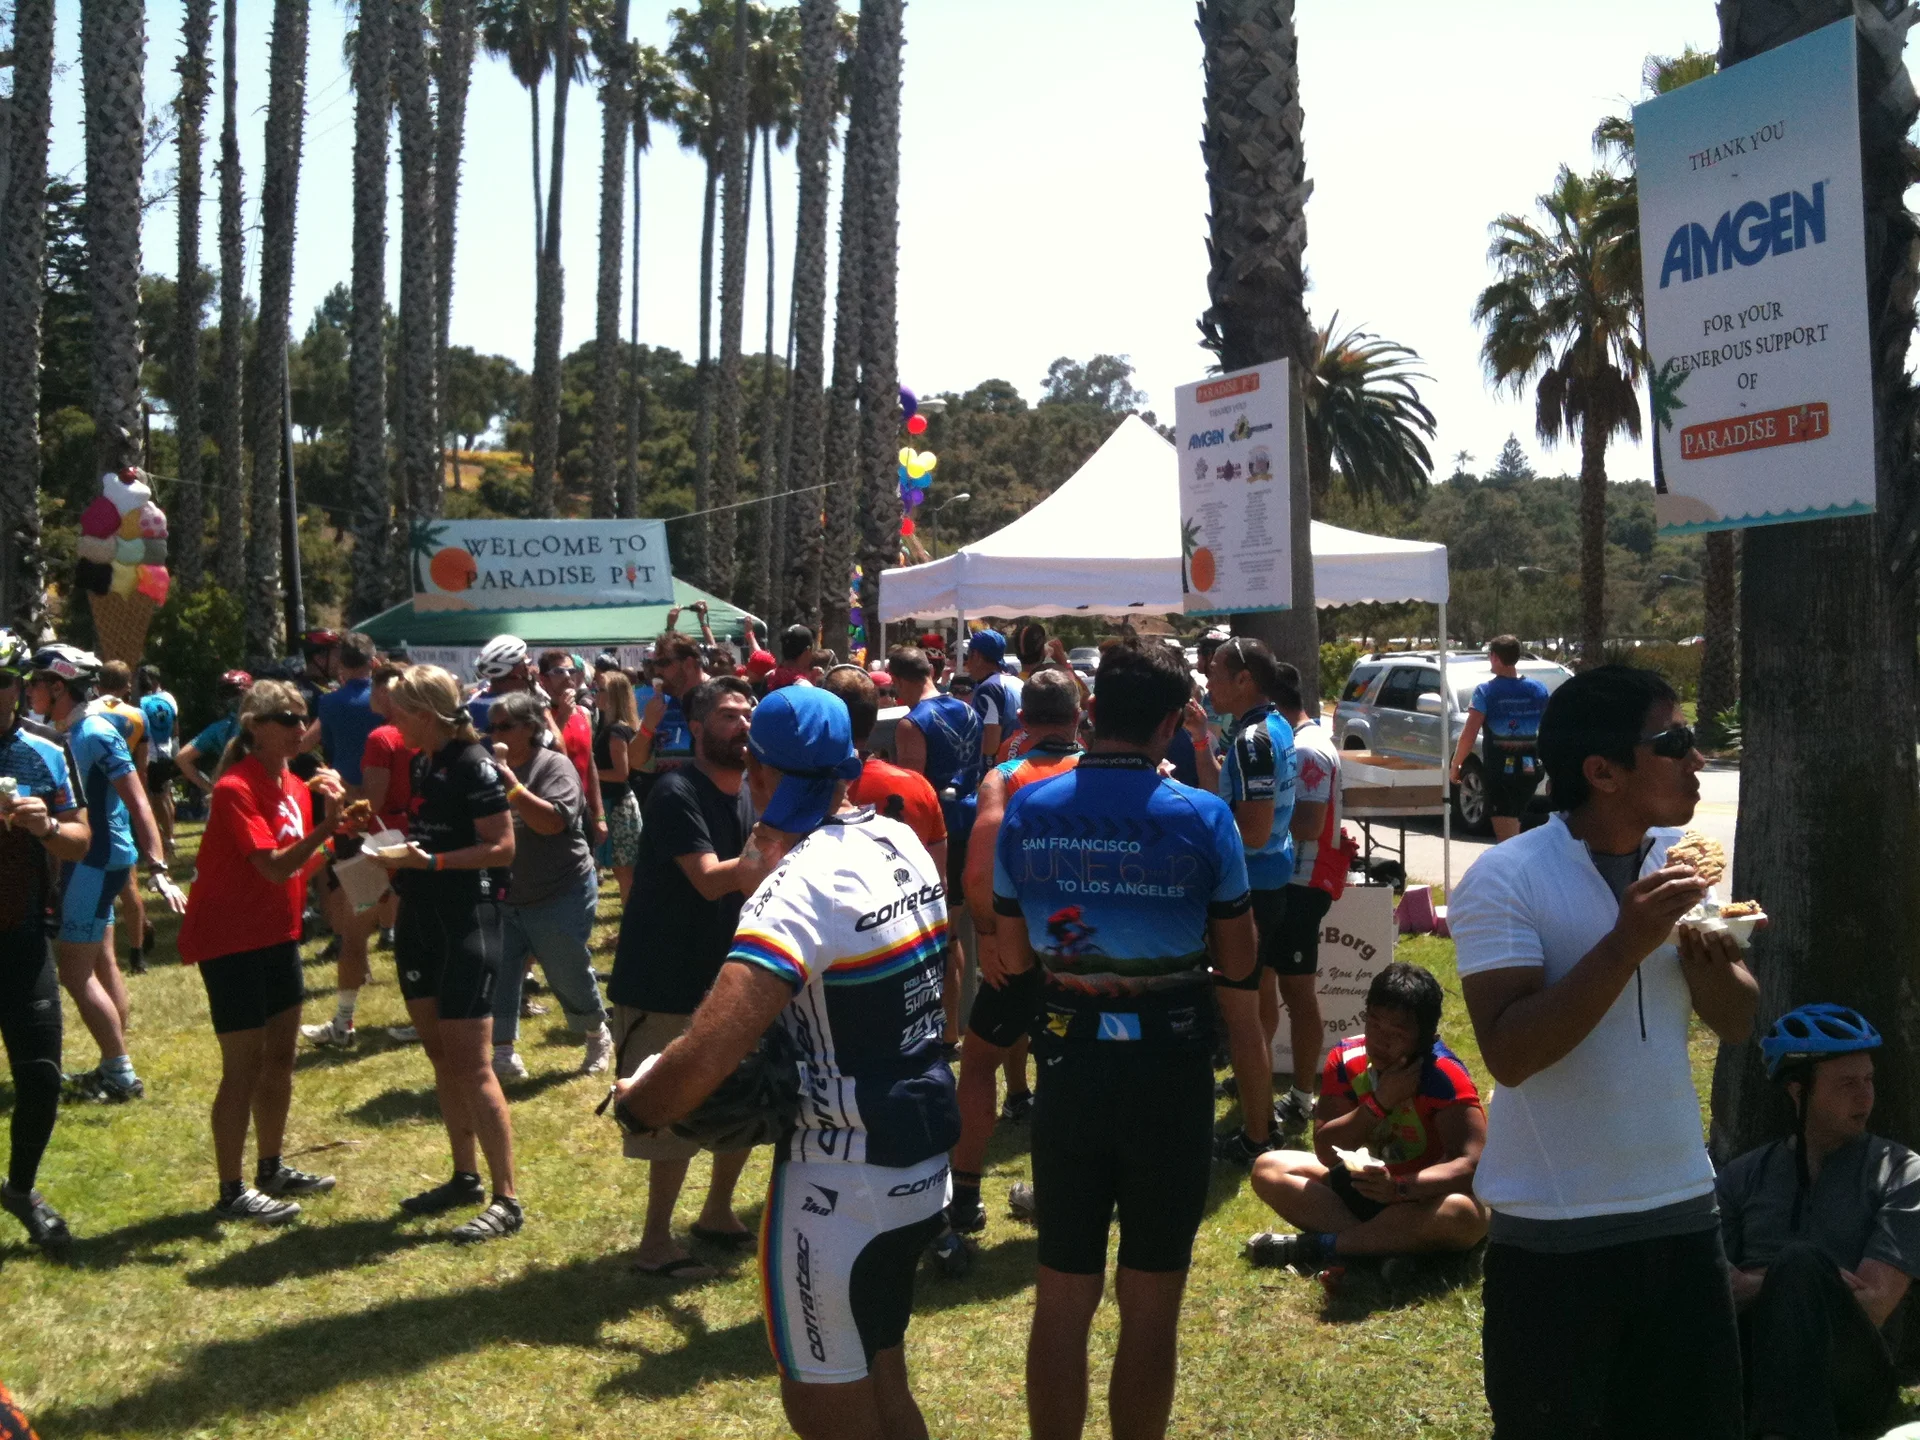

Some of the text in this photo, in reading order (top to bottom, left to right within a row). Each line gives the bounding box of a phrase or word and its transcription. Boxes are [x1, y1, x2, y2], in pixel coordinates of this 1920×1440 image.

[1689, 119, 1785, 171] THANK YOU
[1659, 180, 1827, 290] AMGEN
[1703, 301, 1784, 336] FOR YOUR
[1670, 323, 1829, 374] GENEROUS SUPPORT
[1737, 372, 1758, 390] OF
[1188, 428, 1225, 451] AMGEN
[1684, 416, 1778, 455] PARADISE
[463, 534, 647, 558] WELCOME TO
[465, 565, 596, 590] PARADISE
[1022, 838, 1141, 853] SAN FRANCISCO
[1016, 850, 1107, 887] JUNE
[1119, 850, 1146, 887] 6
[1057, 879, 1185, 898] TO LOS ANGELES
[1329, 967, 1351, 980] You
[1355, 968, 1374, 981] for
[1317, 983, 1368, 998] Littering
[796, 1231, 826, 1363] corratec
